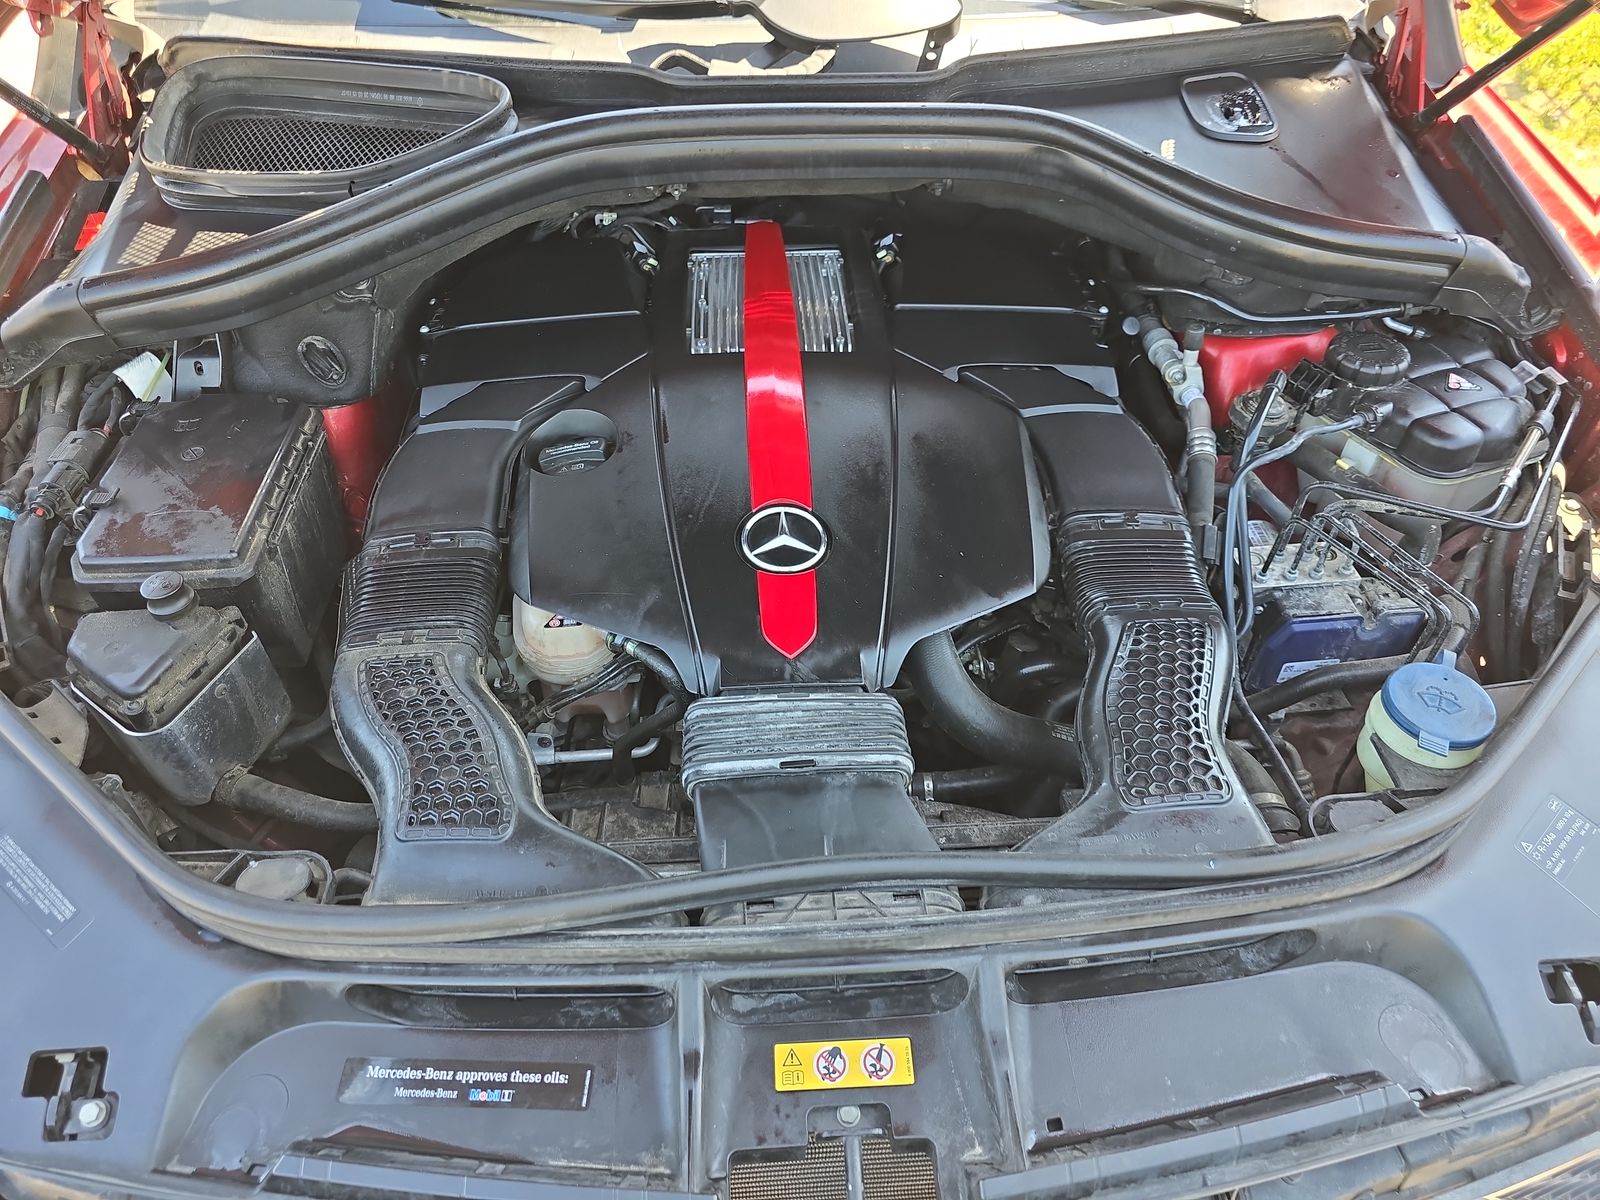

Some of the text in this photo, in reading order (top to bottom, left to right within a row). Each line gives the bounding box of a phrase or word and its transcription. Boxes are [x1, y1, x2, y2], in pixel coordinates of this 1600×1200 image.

[1537, 832, 1556, 854] R-134a
[366, 1065, 569, 1085] Mercedes-Benz approves these oils:
[394, 1086, 458, 1099] Mercedes-Benz
[469, 1088, 501, 1102] Mobil
